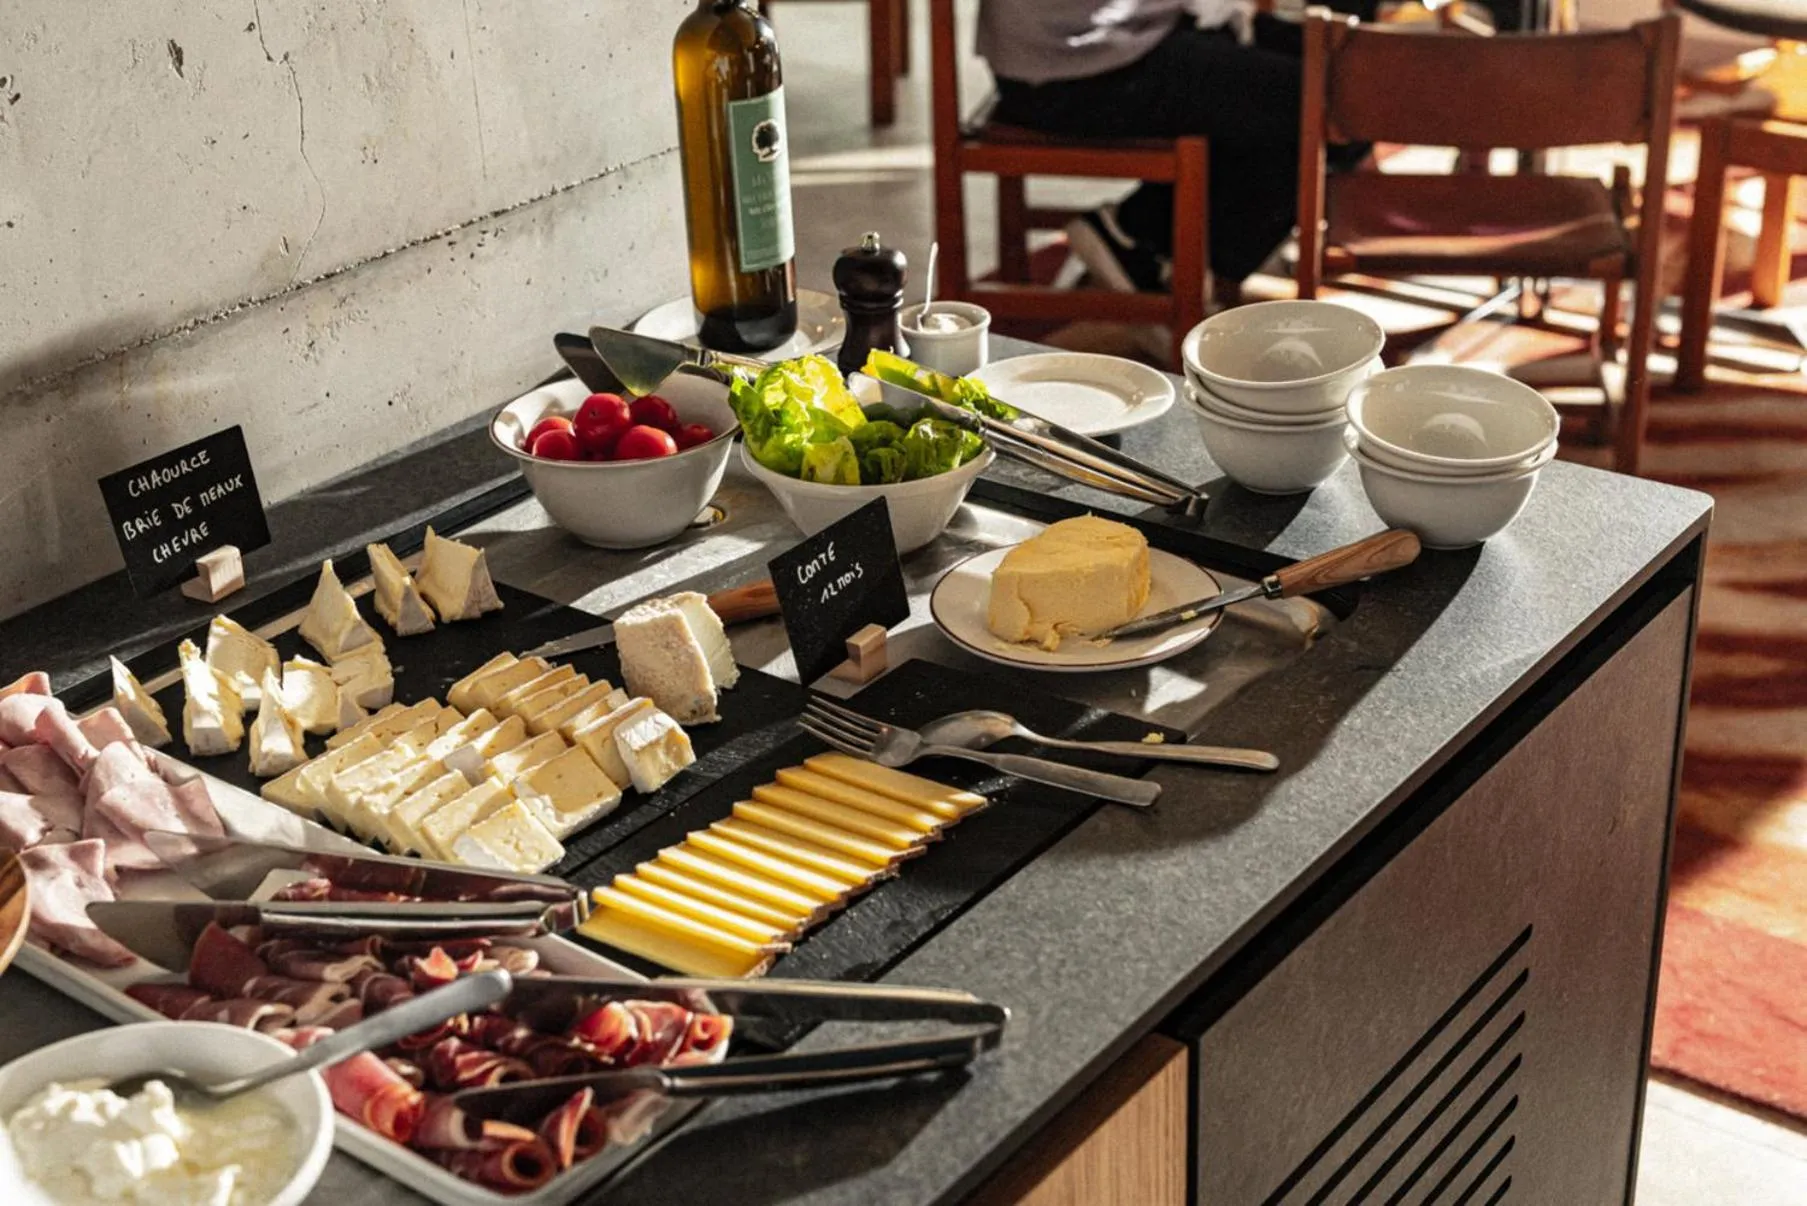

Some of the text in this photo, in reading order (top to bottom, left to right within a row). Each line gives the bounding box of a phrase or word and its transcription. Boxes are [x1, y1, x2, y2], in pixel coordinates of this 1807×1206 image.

[128, 450, 211, 498] CHAOURCE
[171, 496, 193, 519] DE
[152, 521, 210, 564] CHEVRE
[820, 582, 838, 604] 12
